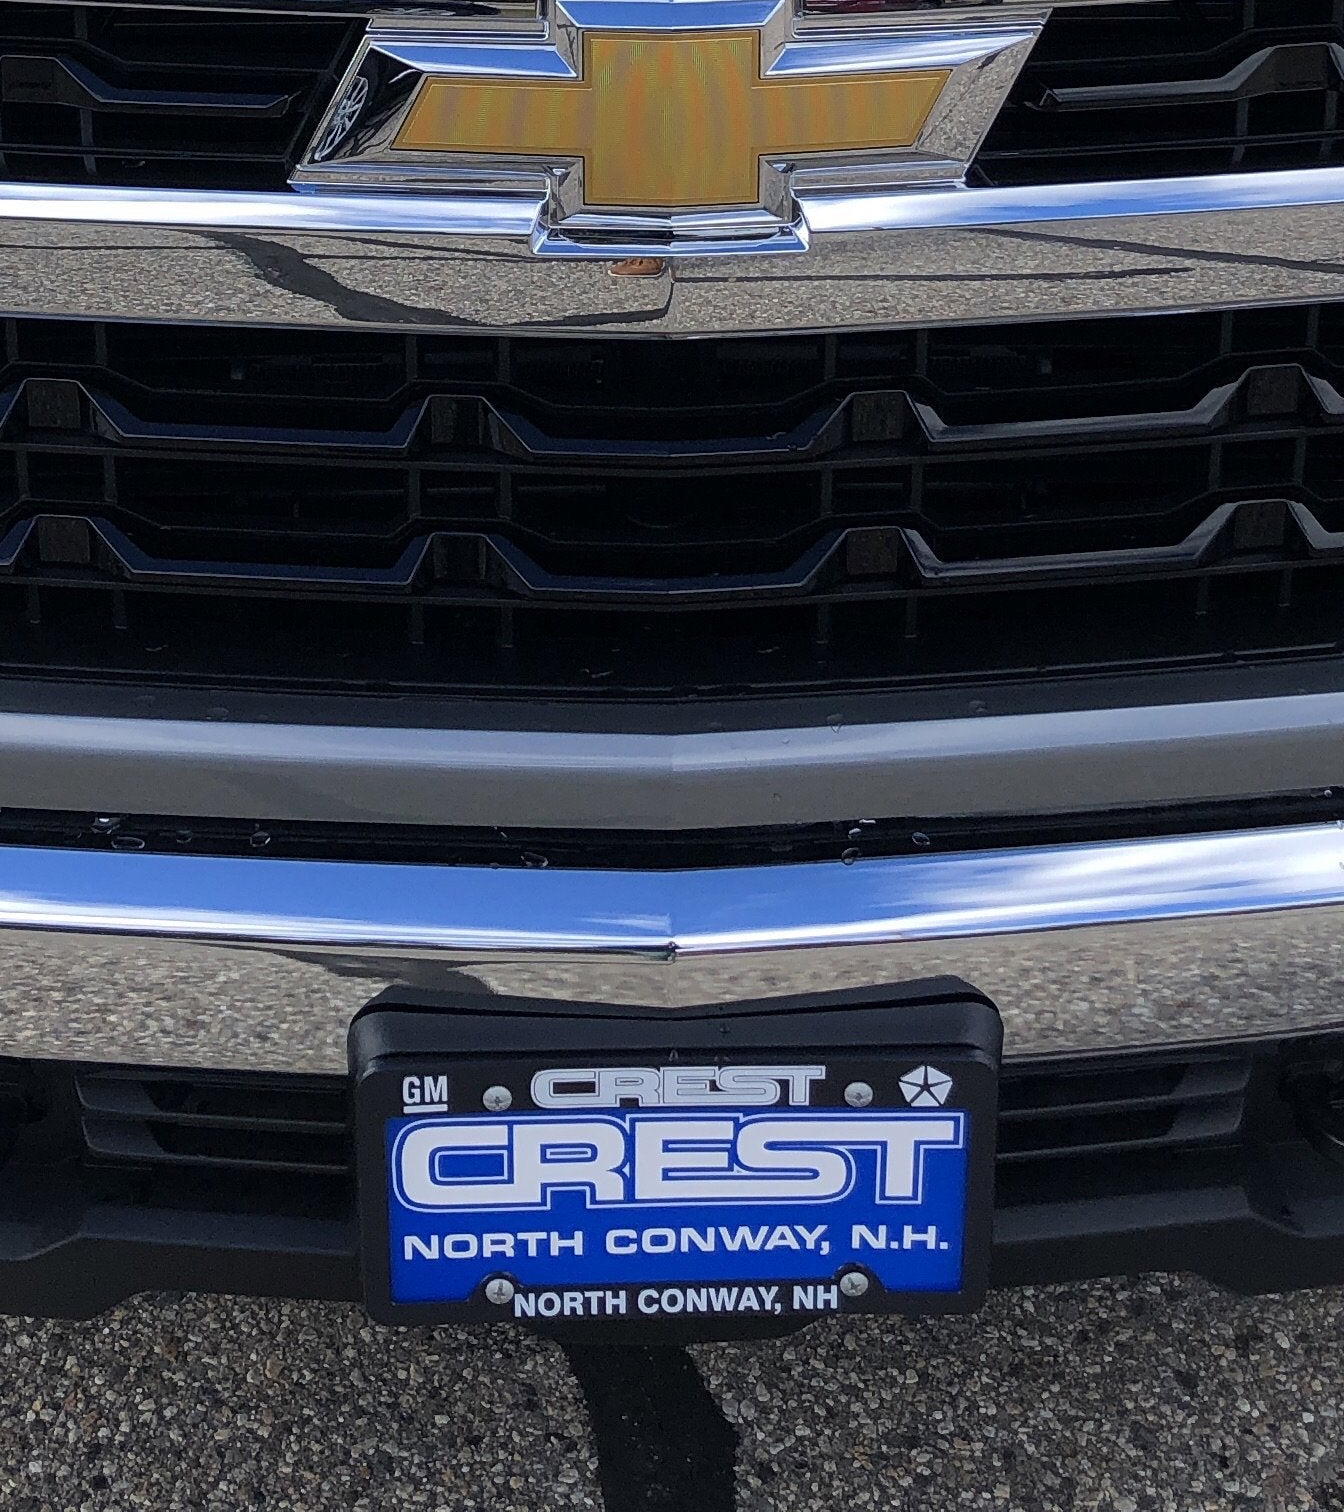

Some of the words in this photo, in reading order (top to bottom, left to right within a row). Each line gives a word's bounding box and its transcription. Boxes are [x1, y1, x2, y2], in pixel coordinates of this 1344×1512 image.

[402, 1075, 449, 1105] GM
[530, 1065, 827, 1109] CREST
[391, 1112, 965, 1214] CREST
[403, 1230, 584, 1261] NORTH
[605, 1224, 831, 1256] CONWAY,
[851, 1224, 949, 1251] N.H.
[513, 1289, 628, 1318] NORTH
[637, 1285, 783, 1316] CONWAY,
[792, 1285, 838, 1311] NH
